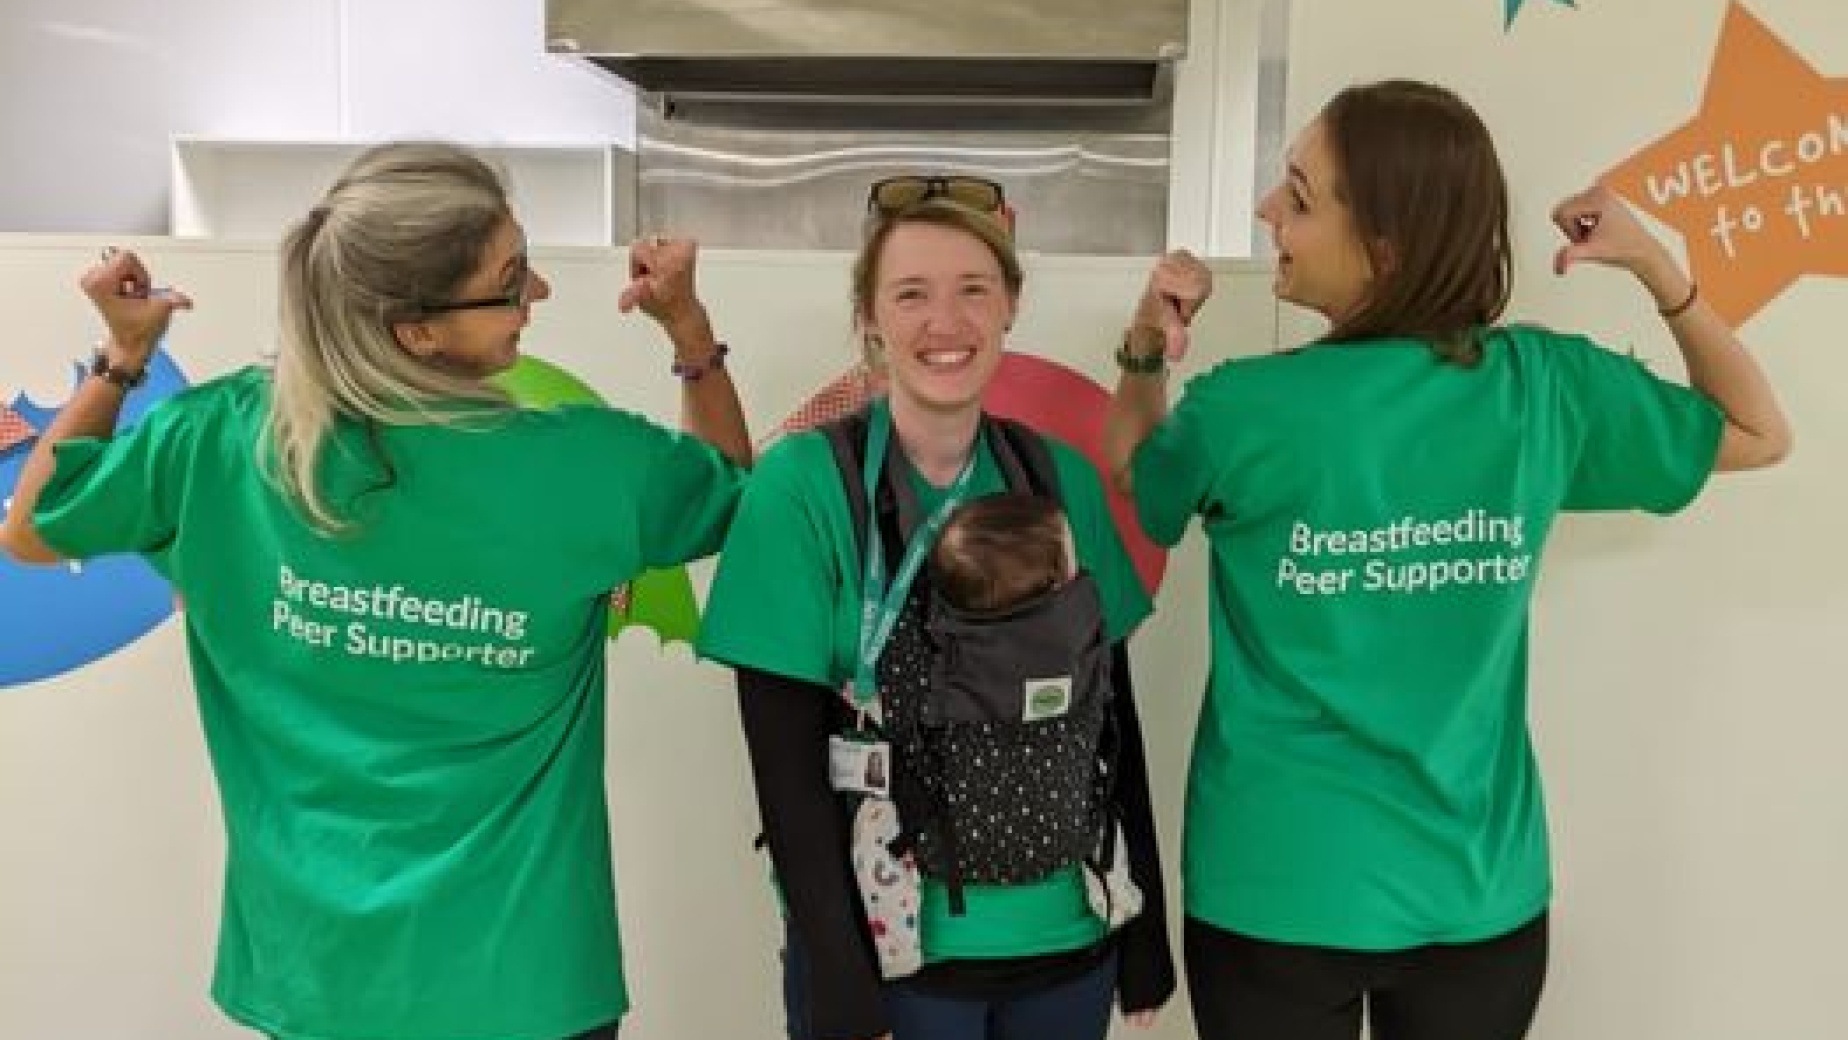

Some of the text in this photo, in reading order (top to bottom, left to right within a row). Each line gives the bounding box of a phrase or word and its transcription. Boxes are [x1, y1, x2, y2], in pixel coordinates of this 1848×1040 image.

[1710, 204, 1762, 258] to
[1289, 508, 1526, 556] Breastfeeding
[1276, 553, 1532, 594] Peer Supporter
[279, 564, 528, 640] Breastfeeding
[272, 599, 535, 668] Peer Supporter
